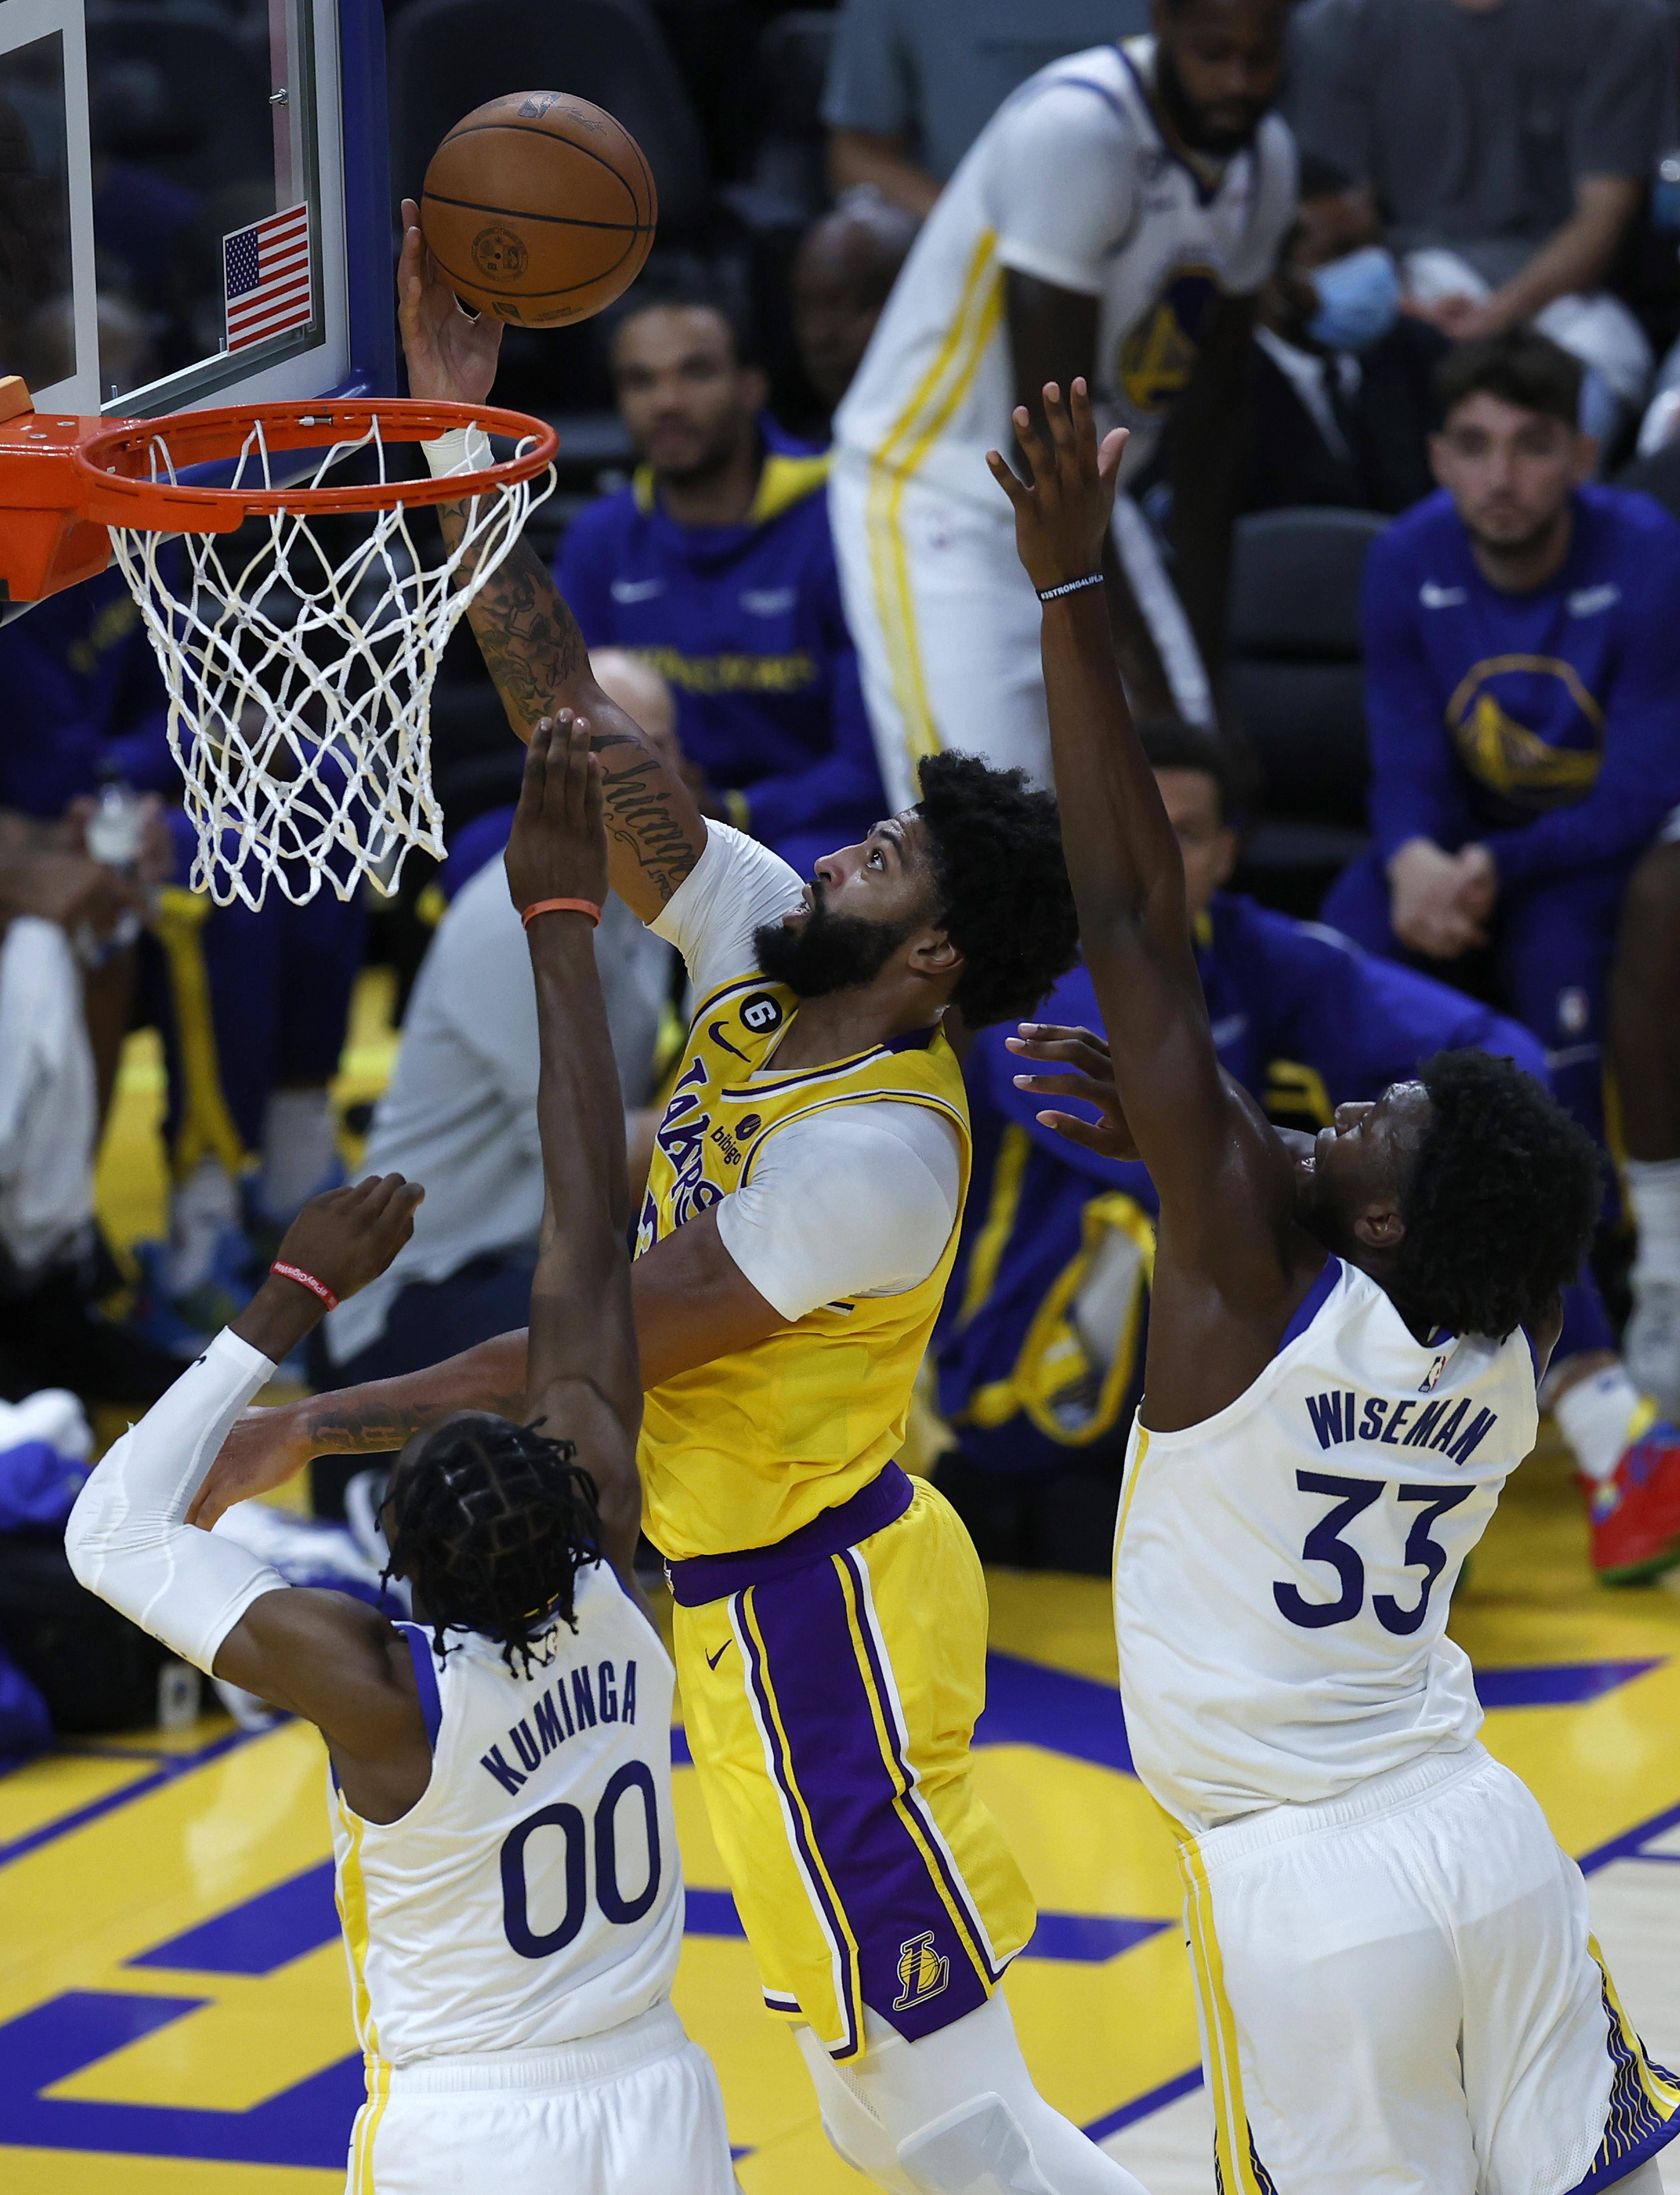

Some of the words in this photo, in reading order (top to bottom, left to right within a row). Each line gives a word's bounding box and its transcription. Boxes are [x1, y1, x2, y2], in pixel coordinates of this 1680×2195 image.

[745, 1000, 777, 1031] 6
[710, 1126, 741, 1165] bibigo
[1305, 1391, 1498, 1466] WISEMAN
[1273, 1469, 1477, 1635] 33
[480, 1660, 637, 1796] KUMINGA
[501, 1760, 661, 1959] 00
